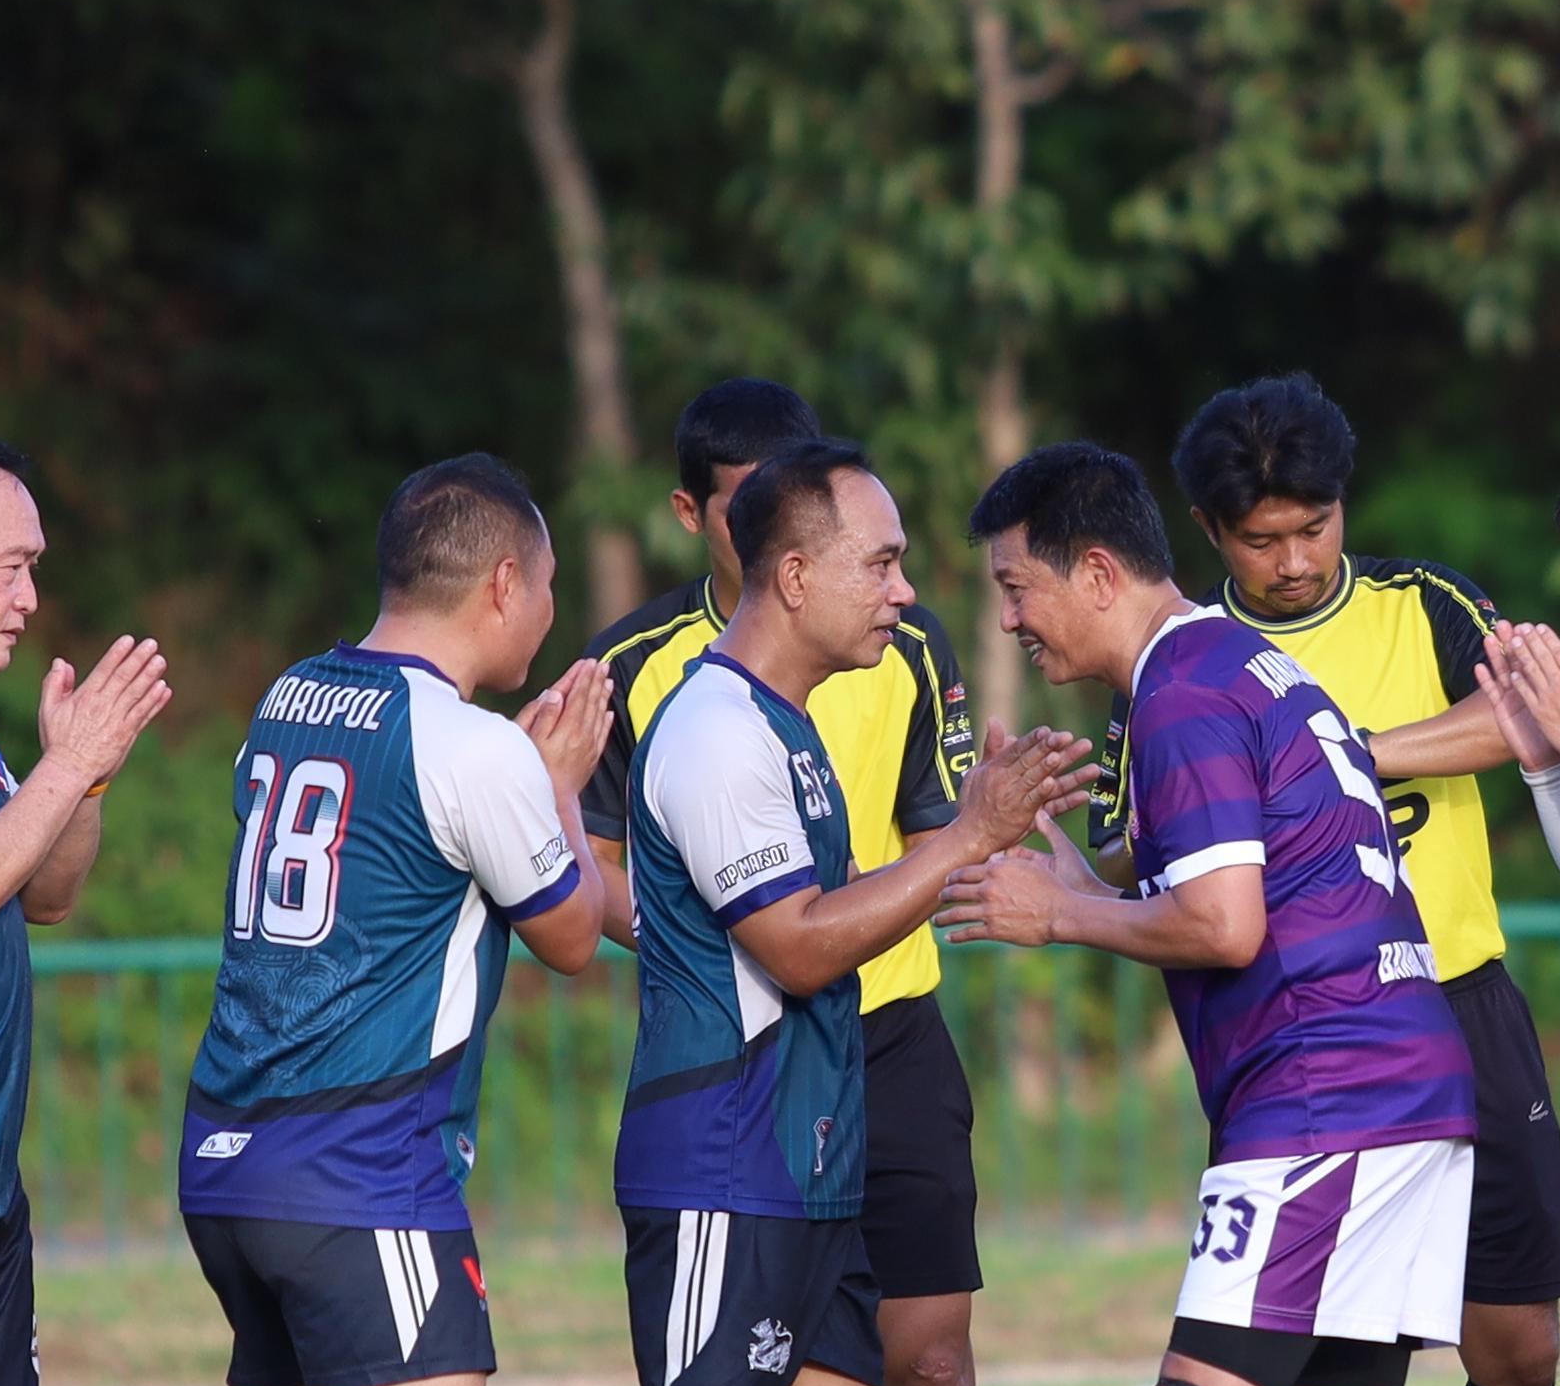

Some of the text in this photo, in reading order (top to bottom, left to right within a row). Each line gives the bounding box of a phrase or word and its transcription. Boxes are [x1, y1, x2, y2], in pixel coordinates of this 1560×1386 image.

[258, 673, 394, 732] NARUPOL
[232, 750, 356, 948] 18
[714, 840, 790, 894] VIP MAESOT
